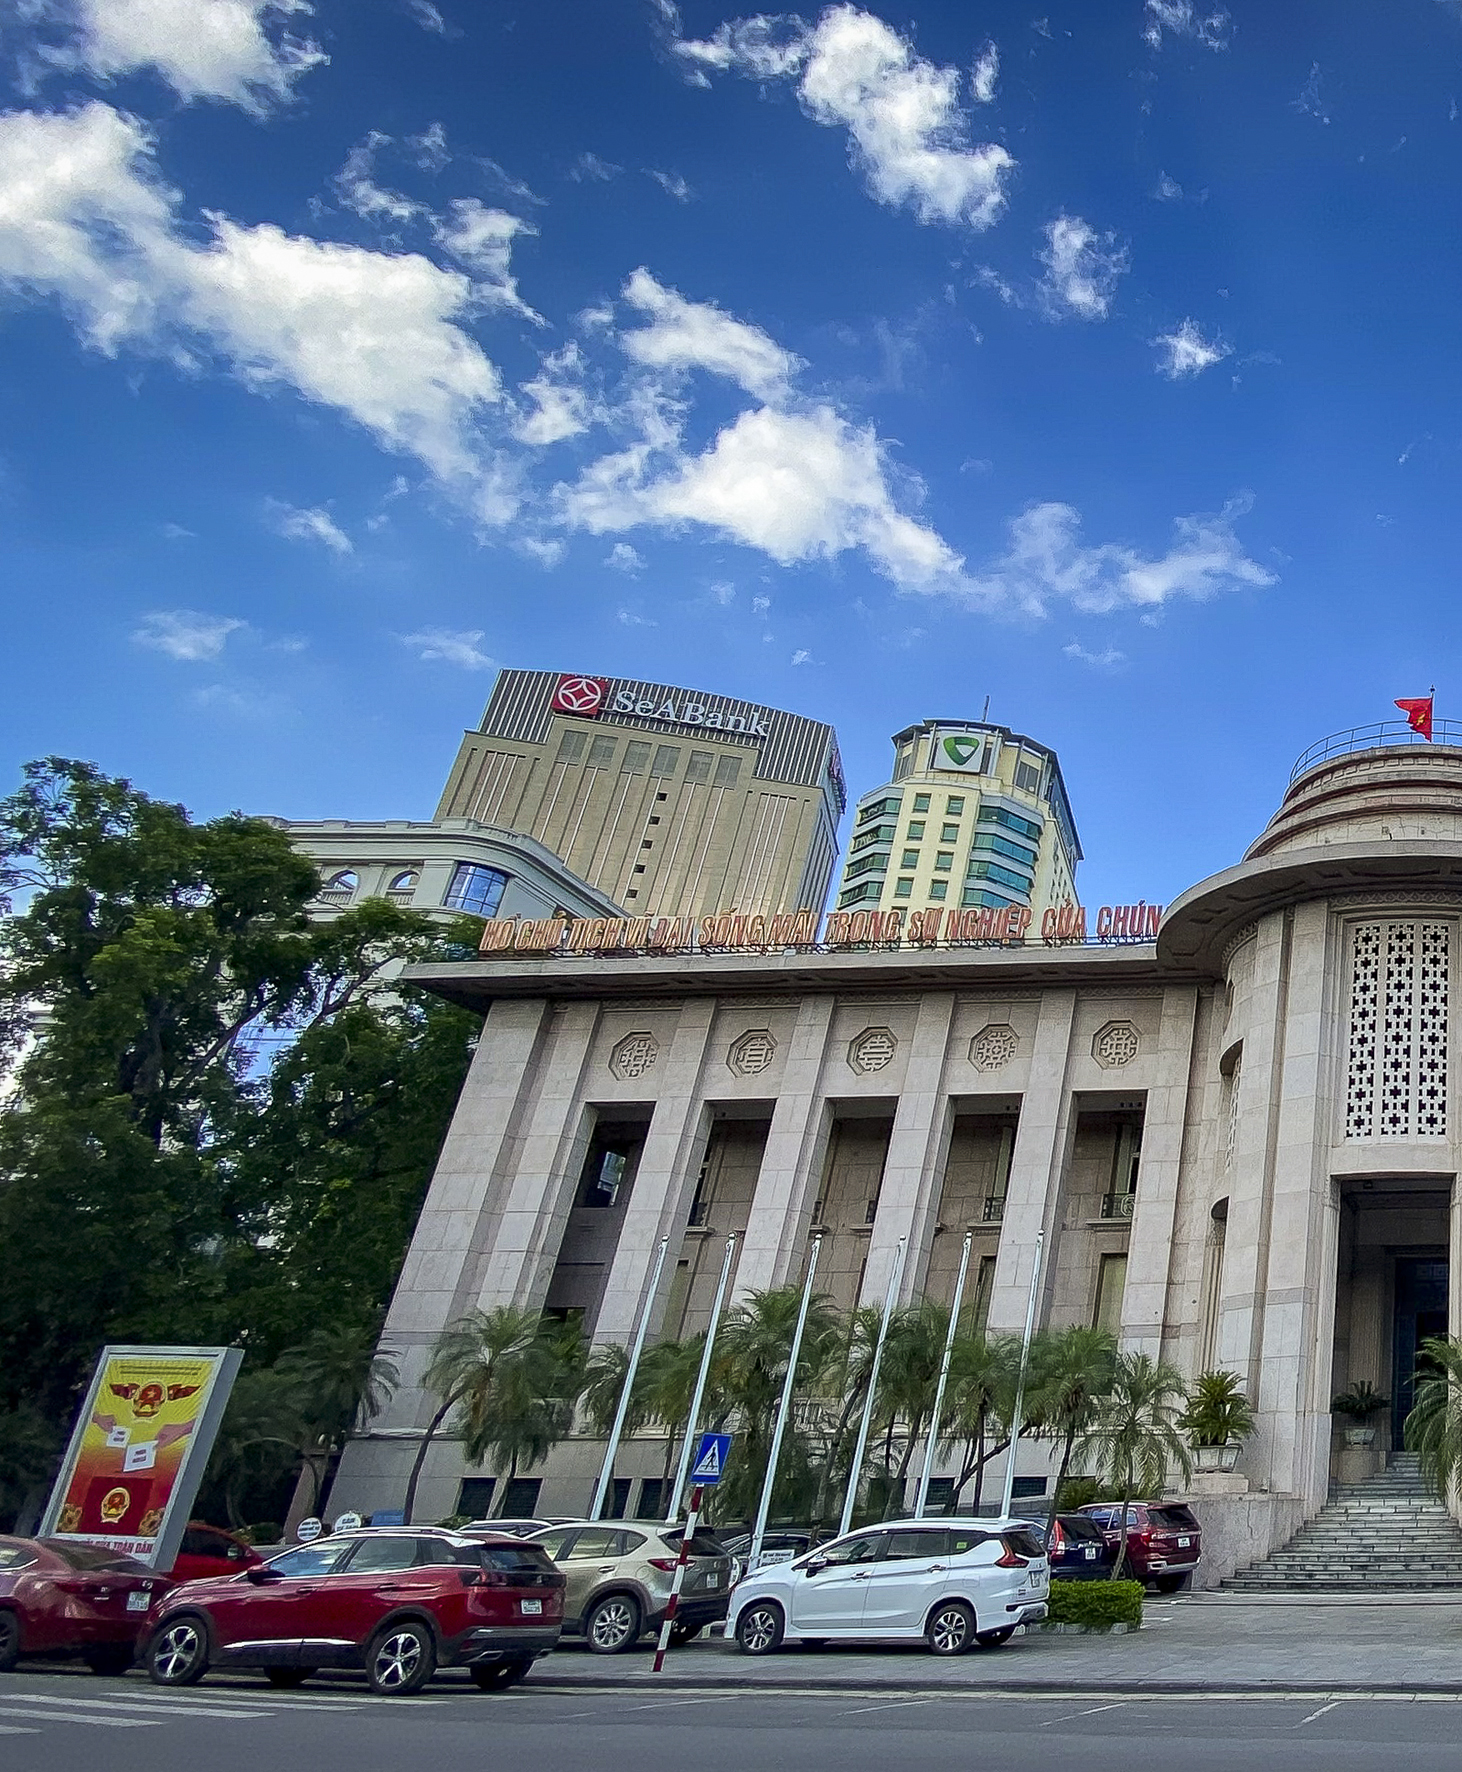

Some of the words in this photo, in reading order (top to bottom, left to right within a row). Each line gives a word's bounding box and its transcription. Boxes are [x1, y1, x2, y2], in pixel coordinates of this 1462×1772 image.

[612, 690, 770, 737] SeABank
[479, 913, 521, 950] HỒ
[514, 911, 566, 949] CHỦ
[698, 907, 767, 946] SỐNG
[768, 907, 819, 945] MÃI
[825, 909, 900, 944] TRONG
[907, 907, 945, 945] SỰ
[945, 903, 1033, 943] NGHIỆP
[1041, 898, 1087, 939] CỦA
